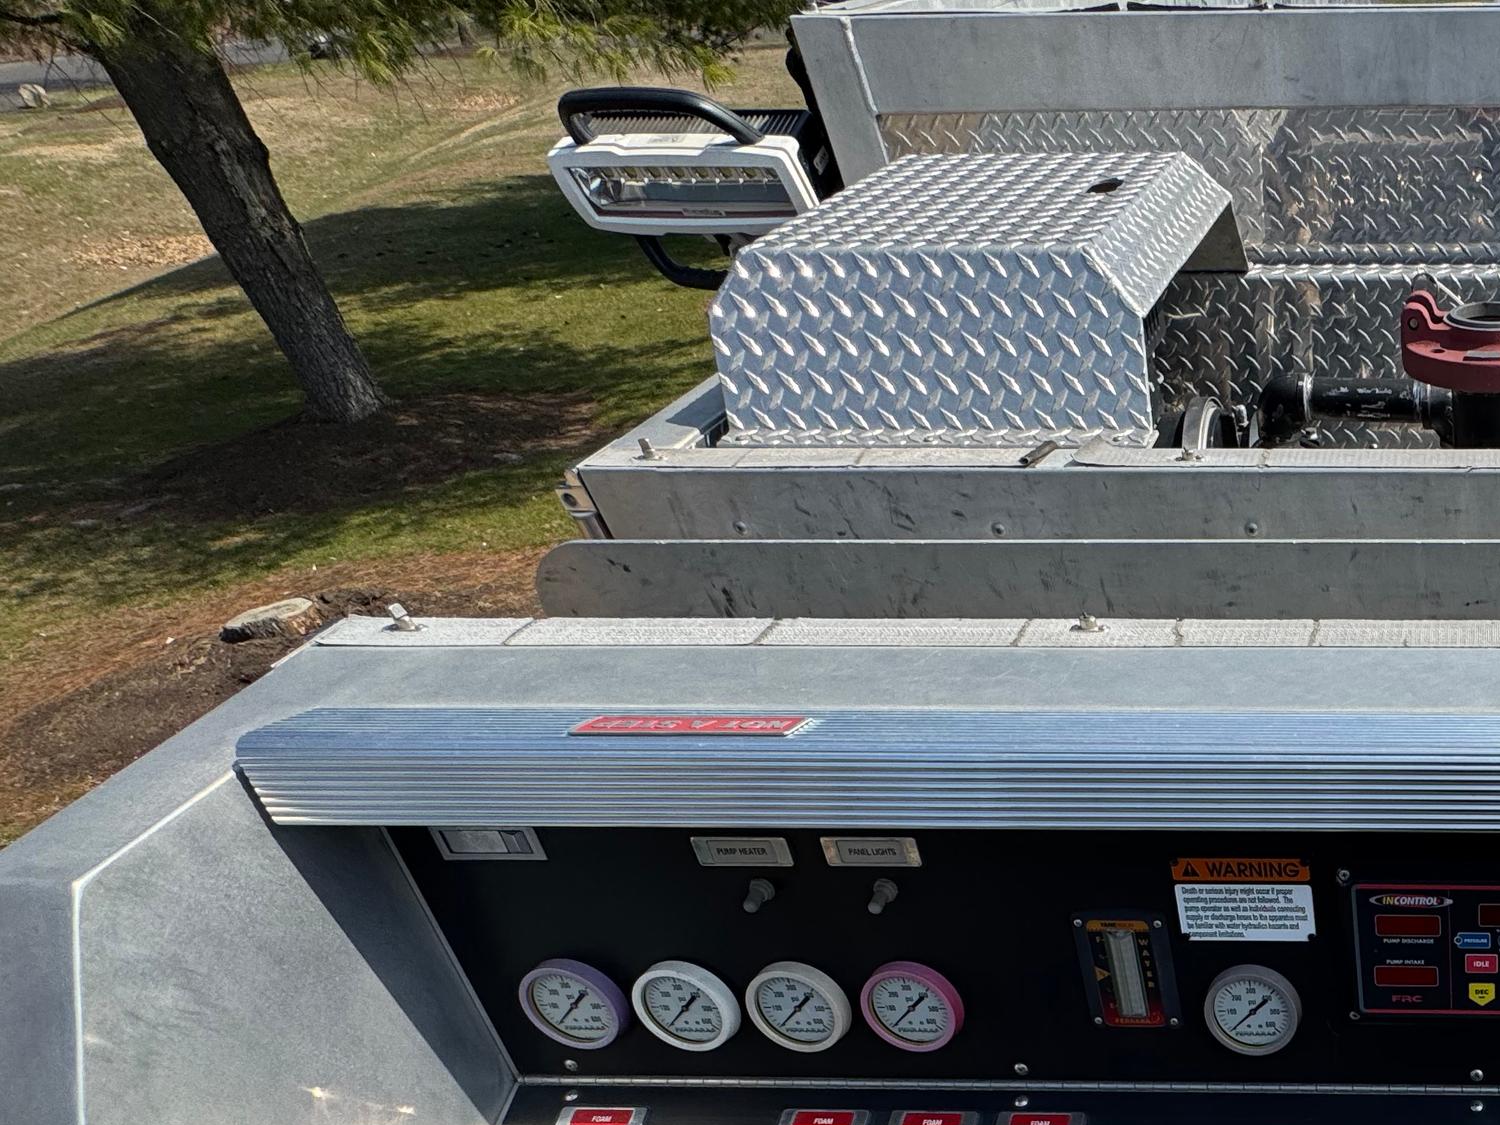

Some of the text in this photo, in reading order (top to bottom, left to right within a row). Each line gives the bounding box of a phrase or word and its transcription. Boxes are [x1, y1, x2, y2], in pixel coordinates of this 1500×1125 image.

[716, 847, 768, 856] PUMP HEATER
[848, 847, 897, 856] PANEL LIGHTS
[1205, 862, 1300, 878] WARNING
[591, 1115, 612, 1123] FOAM
[922, 1118, 943, 1125] FOAM
